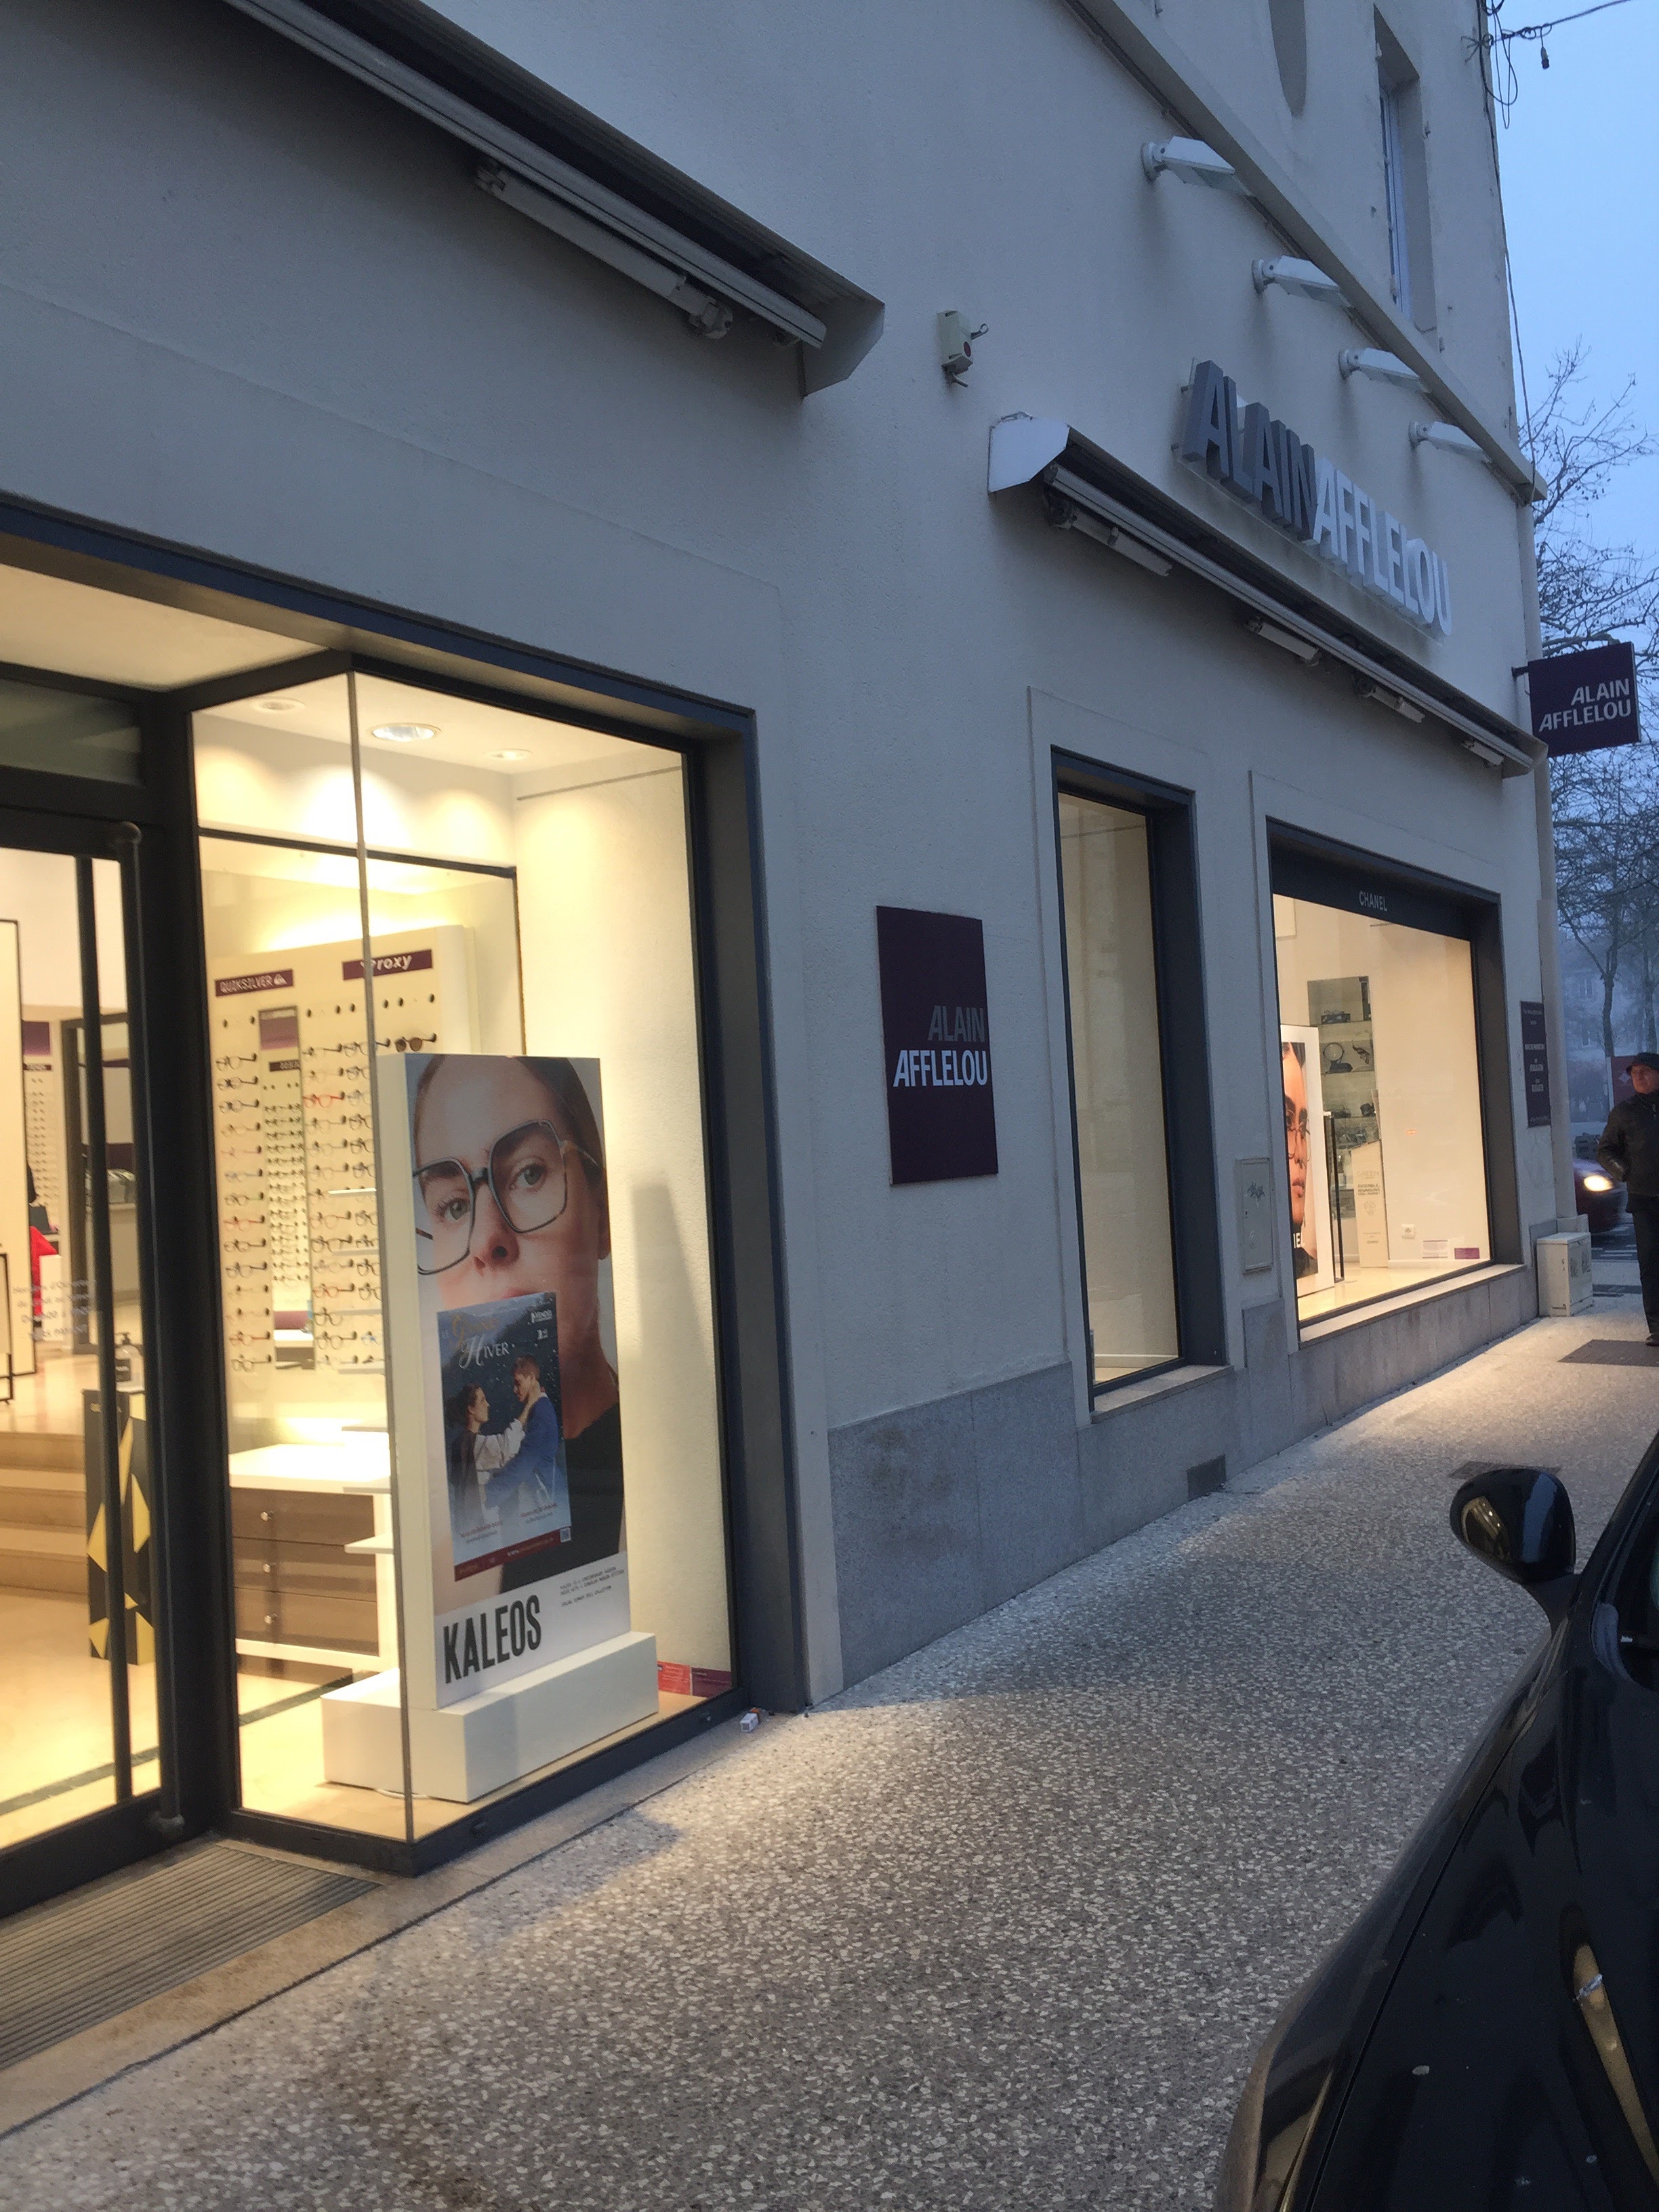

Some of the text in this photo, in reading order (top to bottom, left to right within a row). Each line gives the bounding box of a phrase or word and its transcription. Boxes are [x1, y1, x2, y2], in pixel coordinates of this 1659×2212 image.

[1182, 359, 1452, 637] ALAIN AFFLELOU
[1570, 678, 1631, 706] ALAIN
[1538, 698, 1632, 733] AFFLELOU
[1359, 890, 1388, 912] CHANEL
[377, 955, 412, 970] roxy
[927, 1004, 986, 1043] ALAIN
[893, 1049, 988, 1088] AFFLELOU
[443, 1594, 541, 1685] KALEOS
